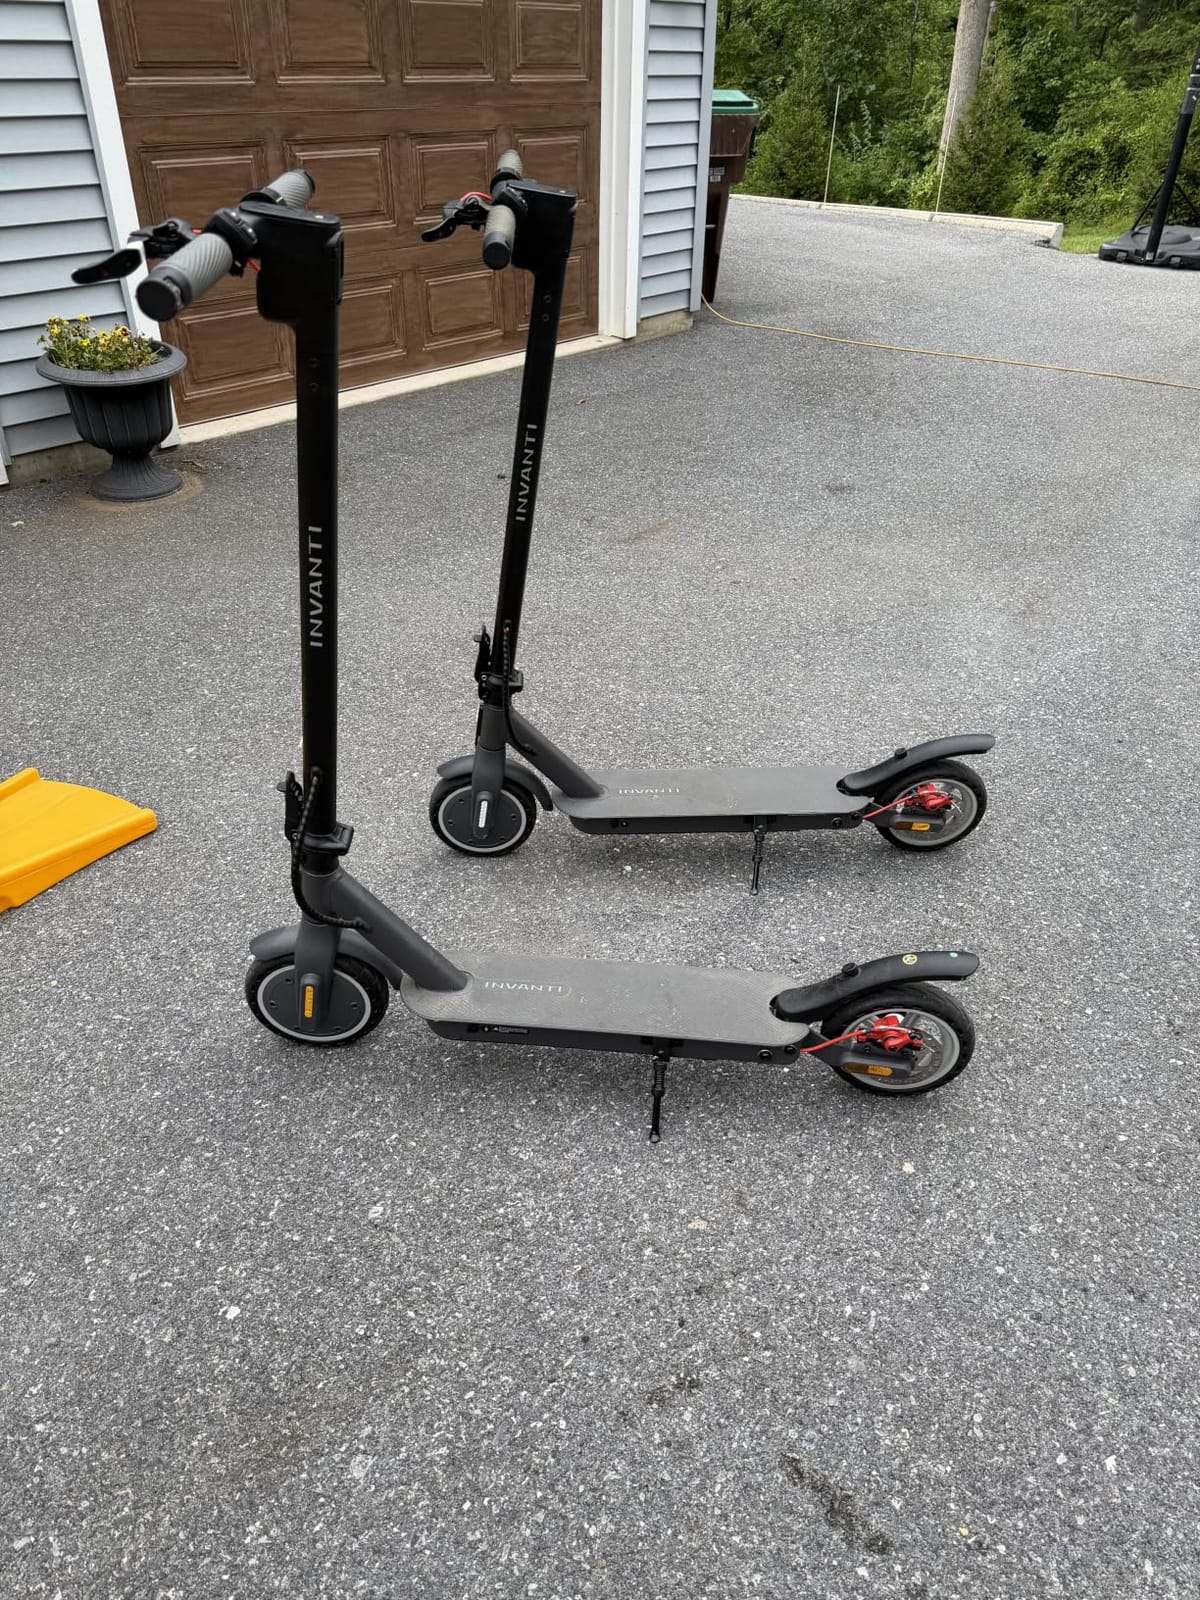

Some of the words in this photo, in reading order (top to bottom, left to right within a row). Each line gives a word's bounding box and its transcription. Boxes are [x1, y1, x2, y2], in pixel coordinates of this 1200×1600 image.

[515, 424, 538, 521] INVANTI
[308, 526, 323, 648] INVANTI
[484, 981, 562, 993] INVANTI
